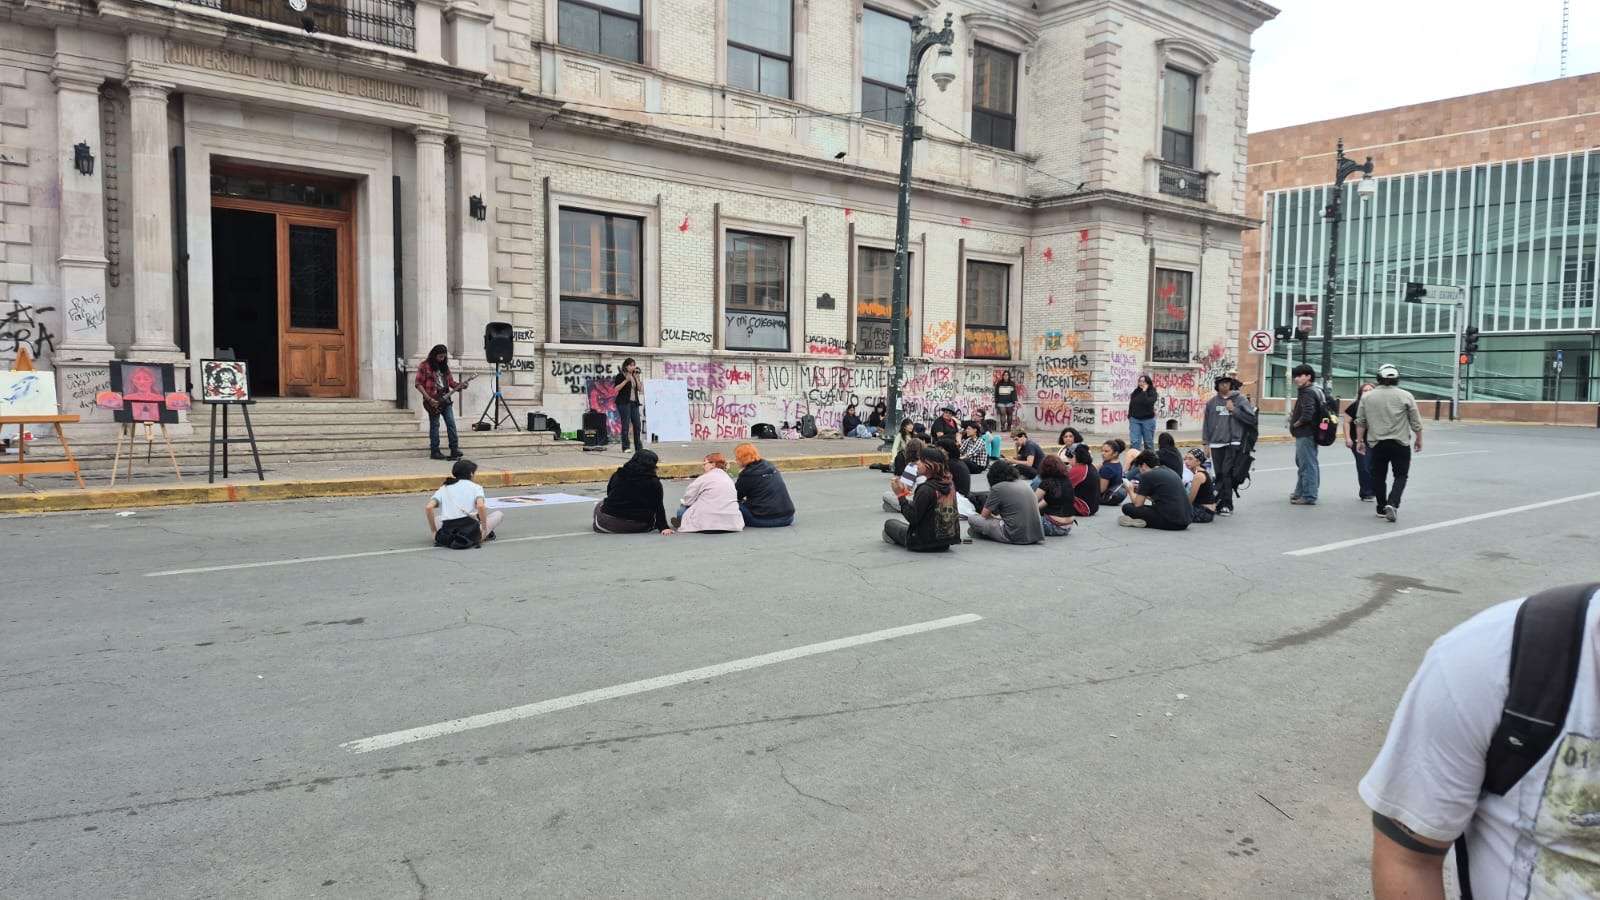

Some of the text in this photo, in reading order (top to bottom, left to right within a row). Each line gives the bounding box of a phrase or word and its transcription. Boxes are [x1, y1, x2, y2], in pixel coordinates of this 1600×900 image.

[171, 46, 421, 108] UNIVERSIDAD AUONOMA DE CHIHUAHUA
[726, 317, 735, 327] Y
[660, 329, 713, 343] CULEROS
[1036, 354, 1088, 372] ARTISTAS
[564, 376, 580, 386] MI
[768, 366, 790, 392] NO
[1034, 406, 1072, 426] UACH
